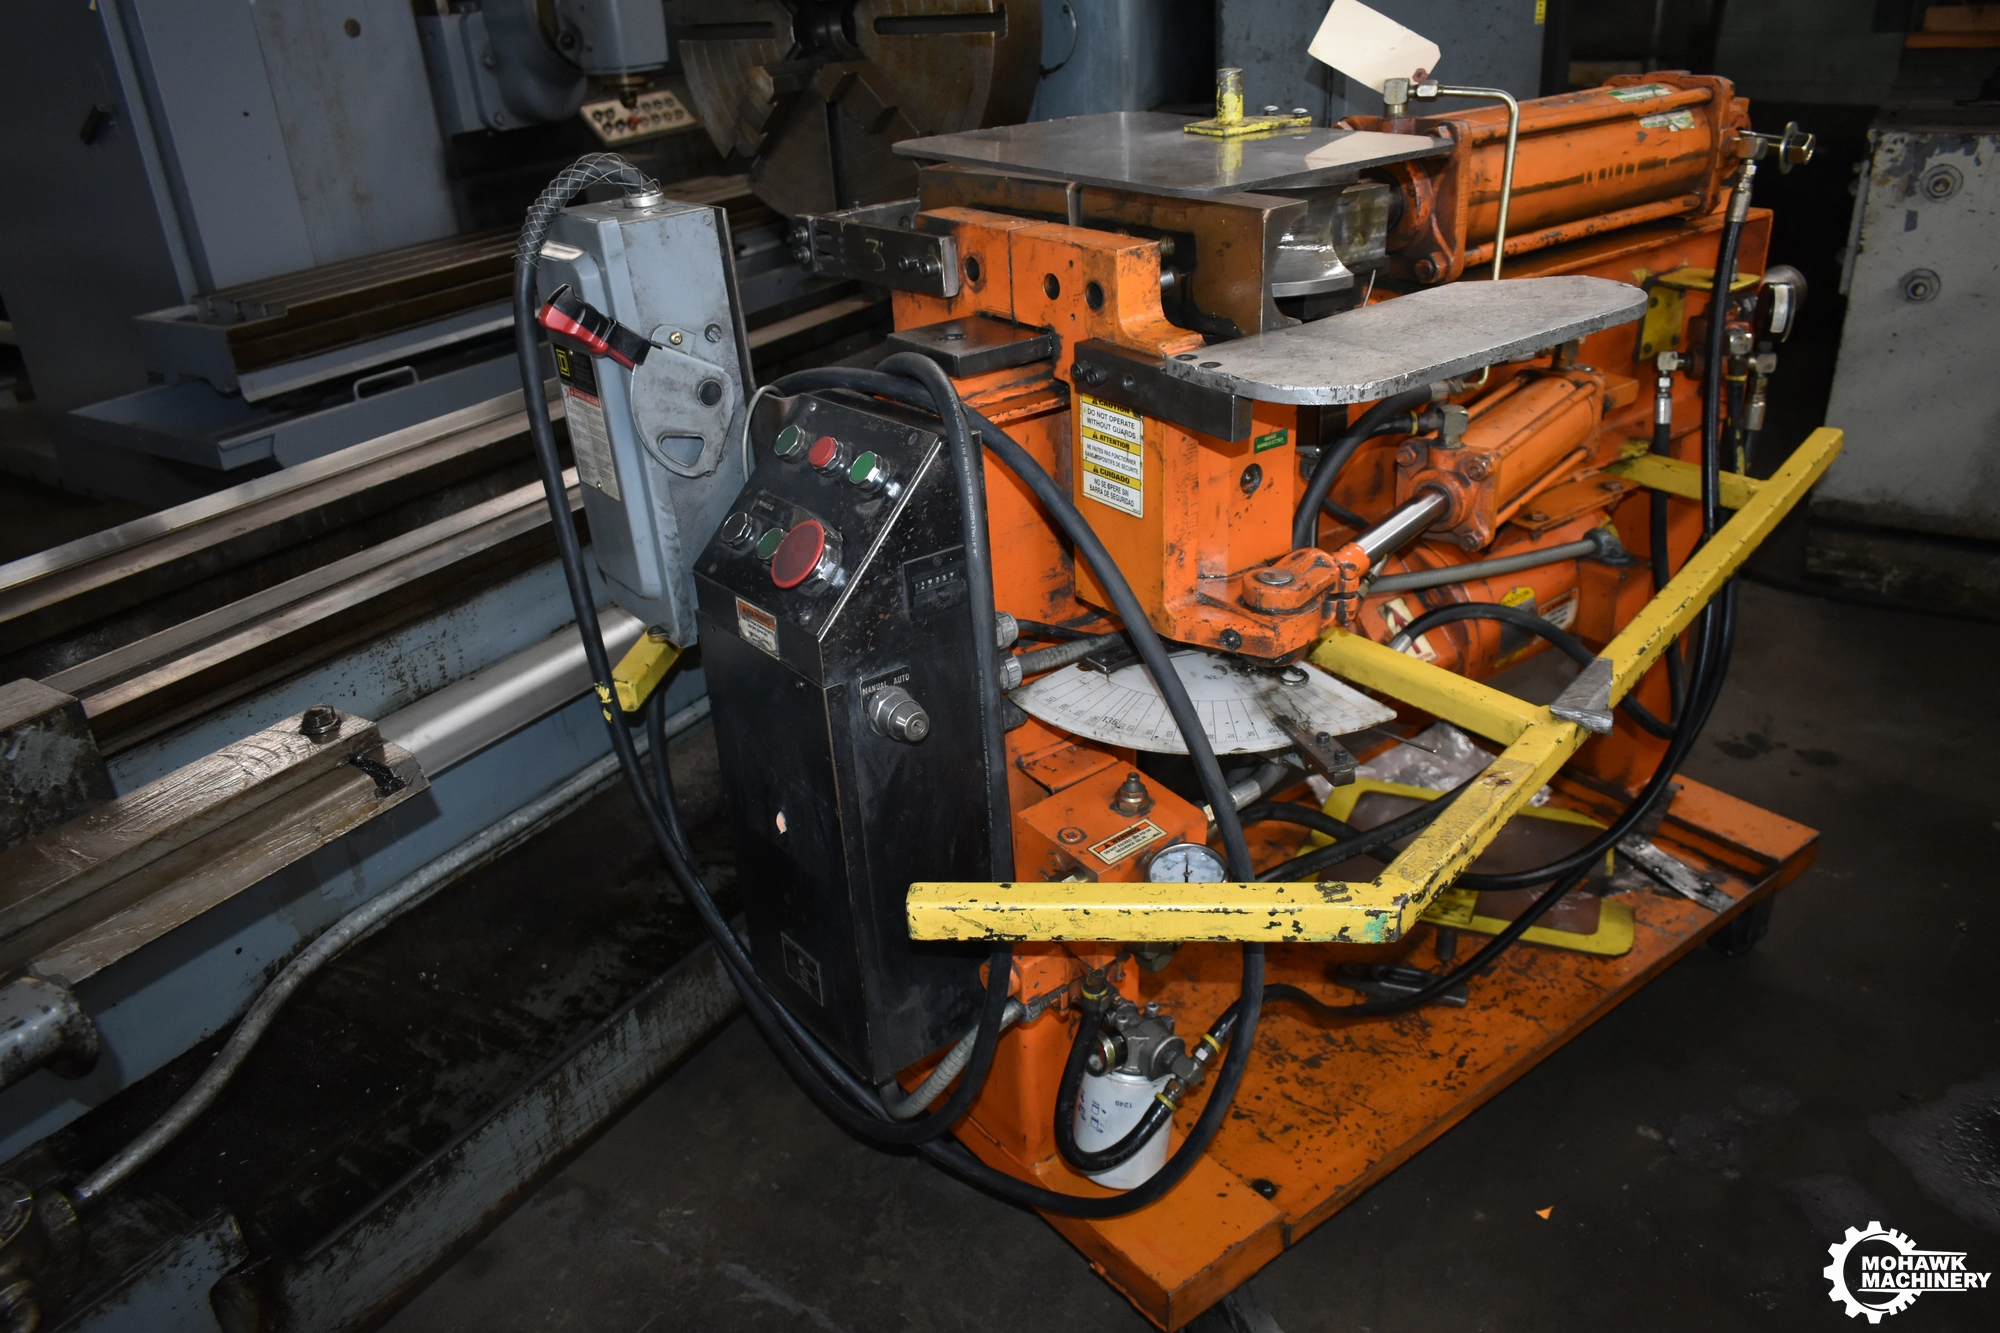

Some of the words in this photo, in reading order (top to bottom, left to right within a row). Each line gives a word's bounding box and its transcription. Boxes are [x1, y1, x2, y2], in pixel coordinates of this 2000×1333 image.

[1087, 408, 1095, 416] DO
[1109, 416, 1135, 429] OPERATE
[1087, 417, 1111, 430] WITHOUT
[1112, 426, 1136, 439] GUARDS
[1100, 434, 1130, 450] ATTENTION
[1100, 468, 1130, 484] CUIDADO
[1090, 484, 1103, 495] BARRA
[1110, 492, 1134, 507] SEGURIDAD
[862, 681, 888, 695] MANUAL
[893, 673, 910, 685] AUTO
[1102, 716, 1120, 726] 135
[1113, 827, 1140, 844] WARNING
